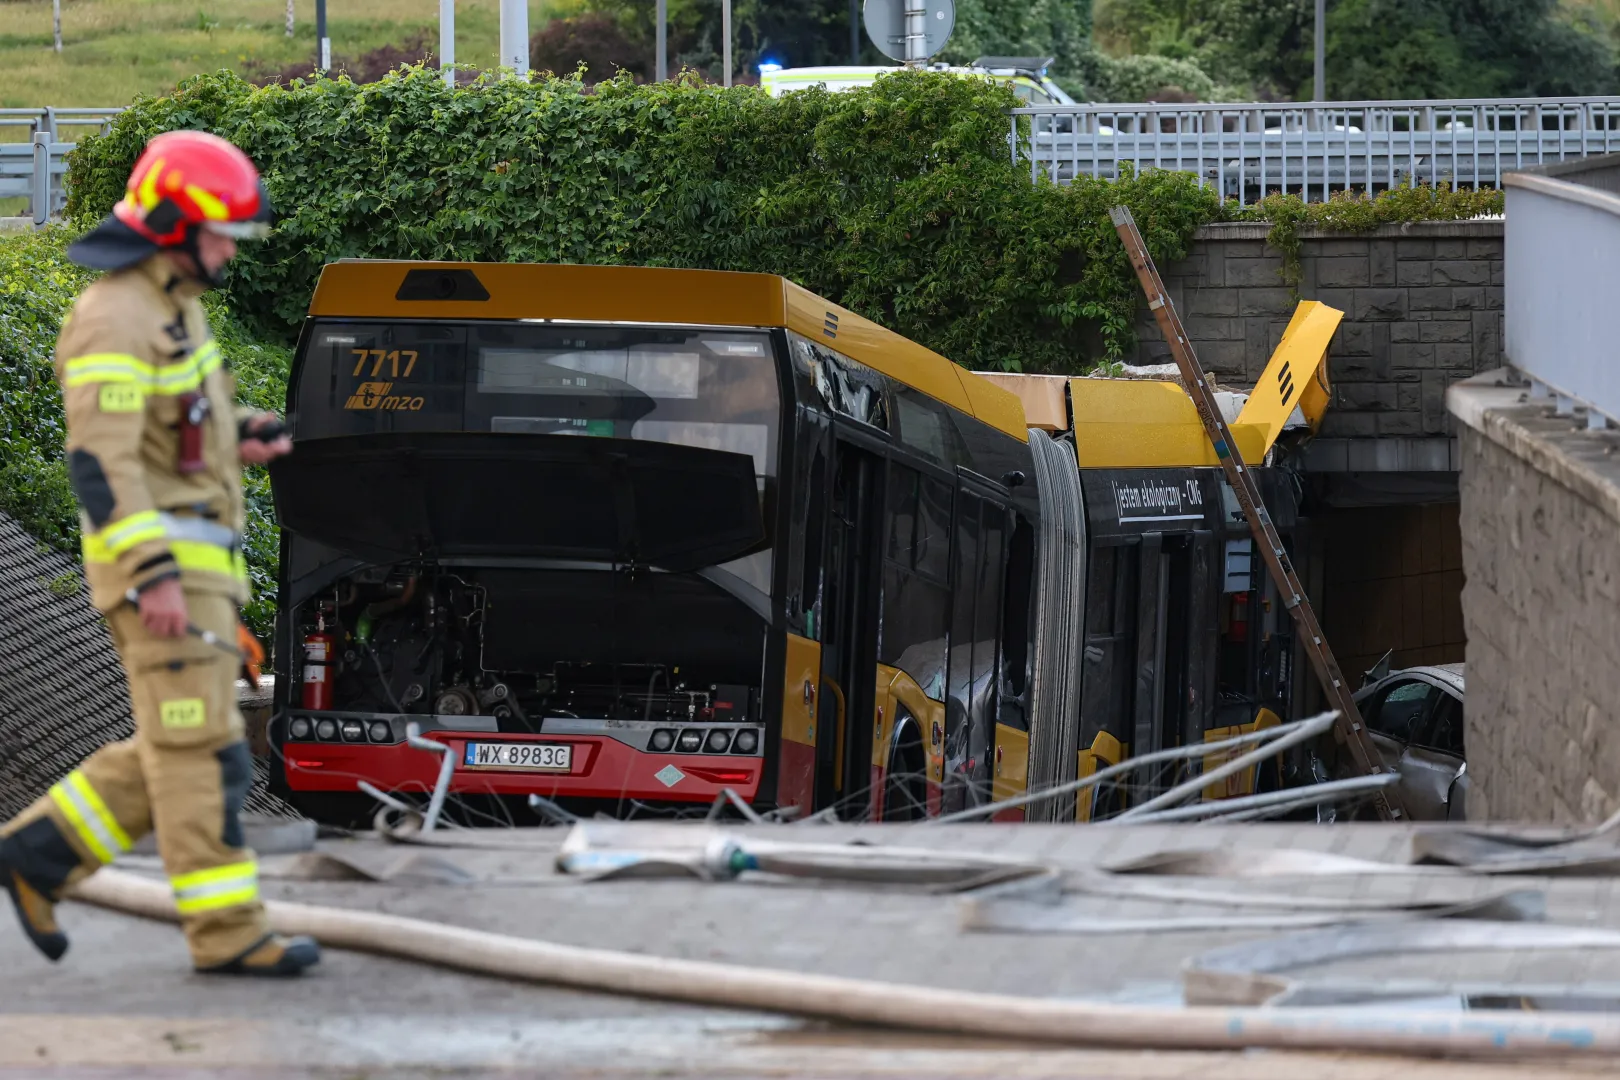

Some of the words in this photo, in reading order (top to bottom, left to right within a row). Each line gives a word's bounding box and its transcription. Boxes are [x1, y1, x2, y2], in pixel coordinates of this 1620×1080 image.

[351, 349, 418, 378] 7717
[379, 395, 425, 412] mza
[1115, 480, 1141, 516] jestem
[1141, 479, 1182, 514] ekologiczny
[1186, 479, 1203, 505] CNG
[479, 745, 502, 763] WX
[509, 746, 566, 766] 8983C
